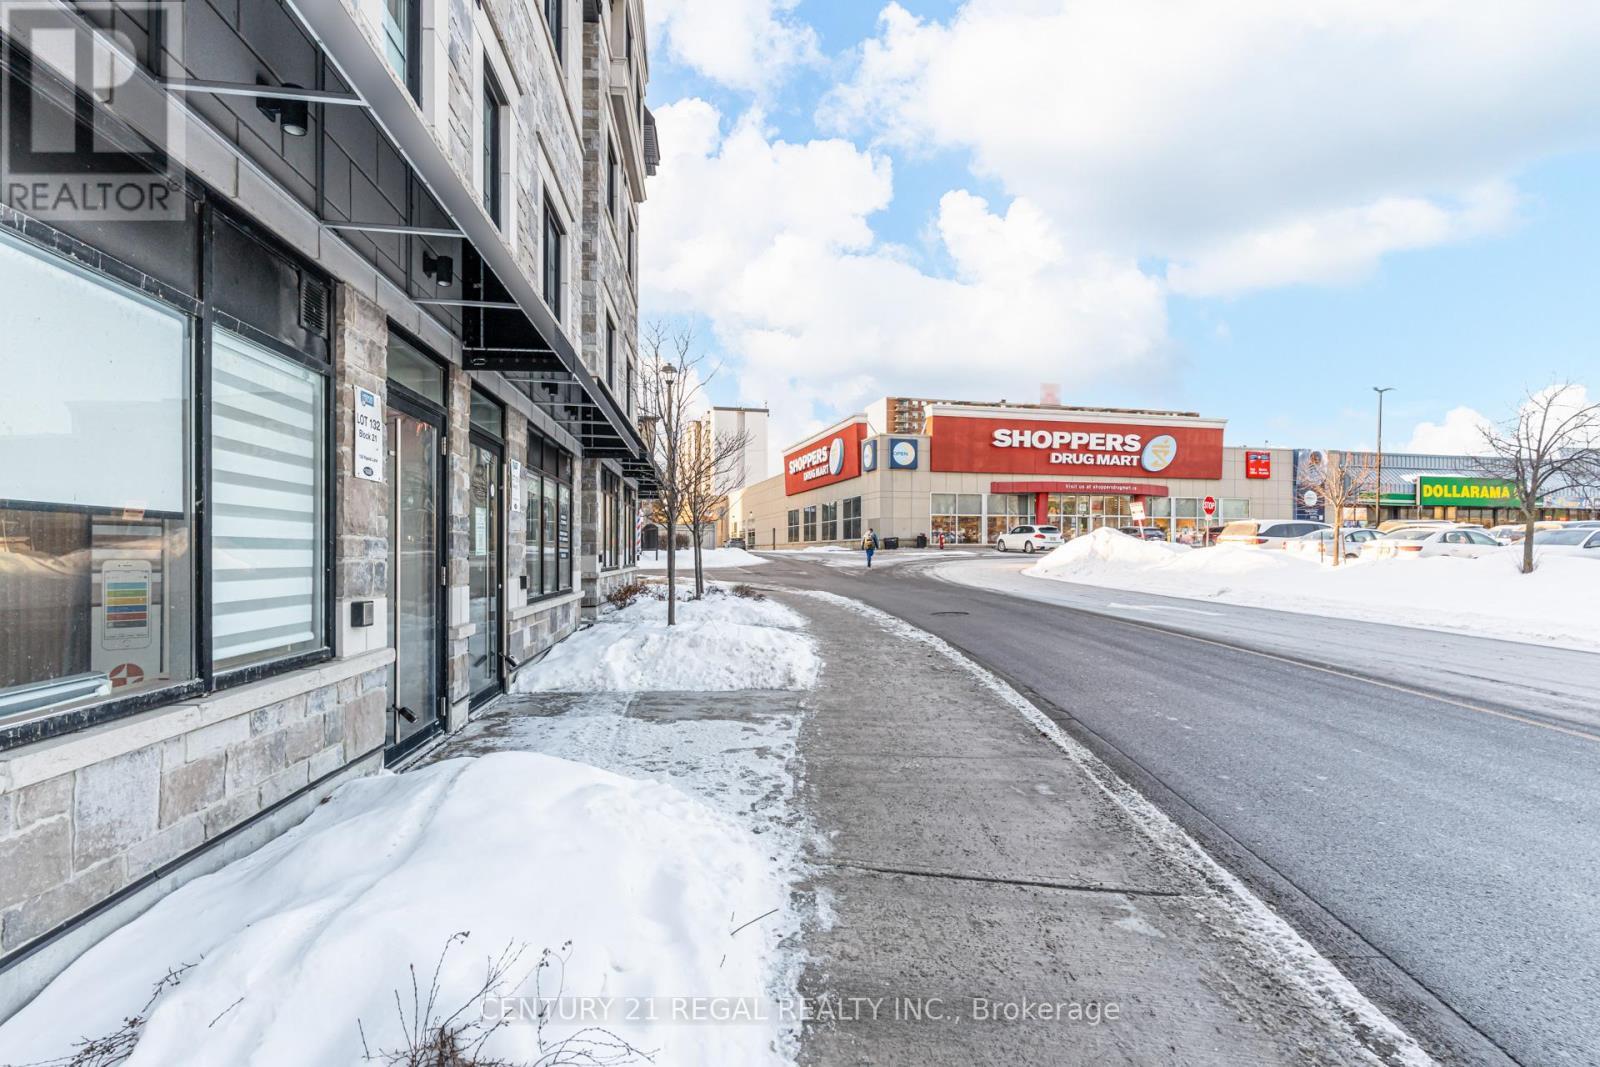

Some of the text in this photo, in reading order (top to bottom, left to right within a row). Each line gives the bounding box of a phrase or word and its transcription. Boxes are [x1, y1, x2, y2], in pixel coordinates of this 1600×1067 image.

[357, 413, 381, 432] LOT 132
[359, 429, 371, 441] Block
[992, 428, 1142, 452] SHOPPERS
[788, 445, 828, 475] SHOPPERS
[1050, 452, 1140, 467] DRUG MART
[1423, 484, 1510, 499] DOLLARAMA
[1203, 501, 1216, 510] STOP
